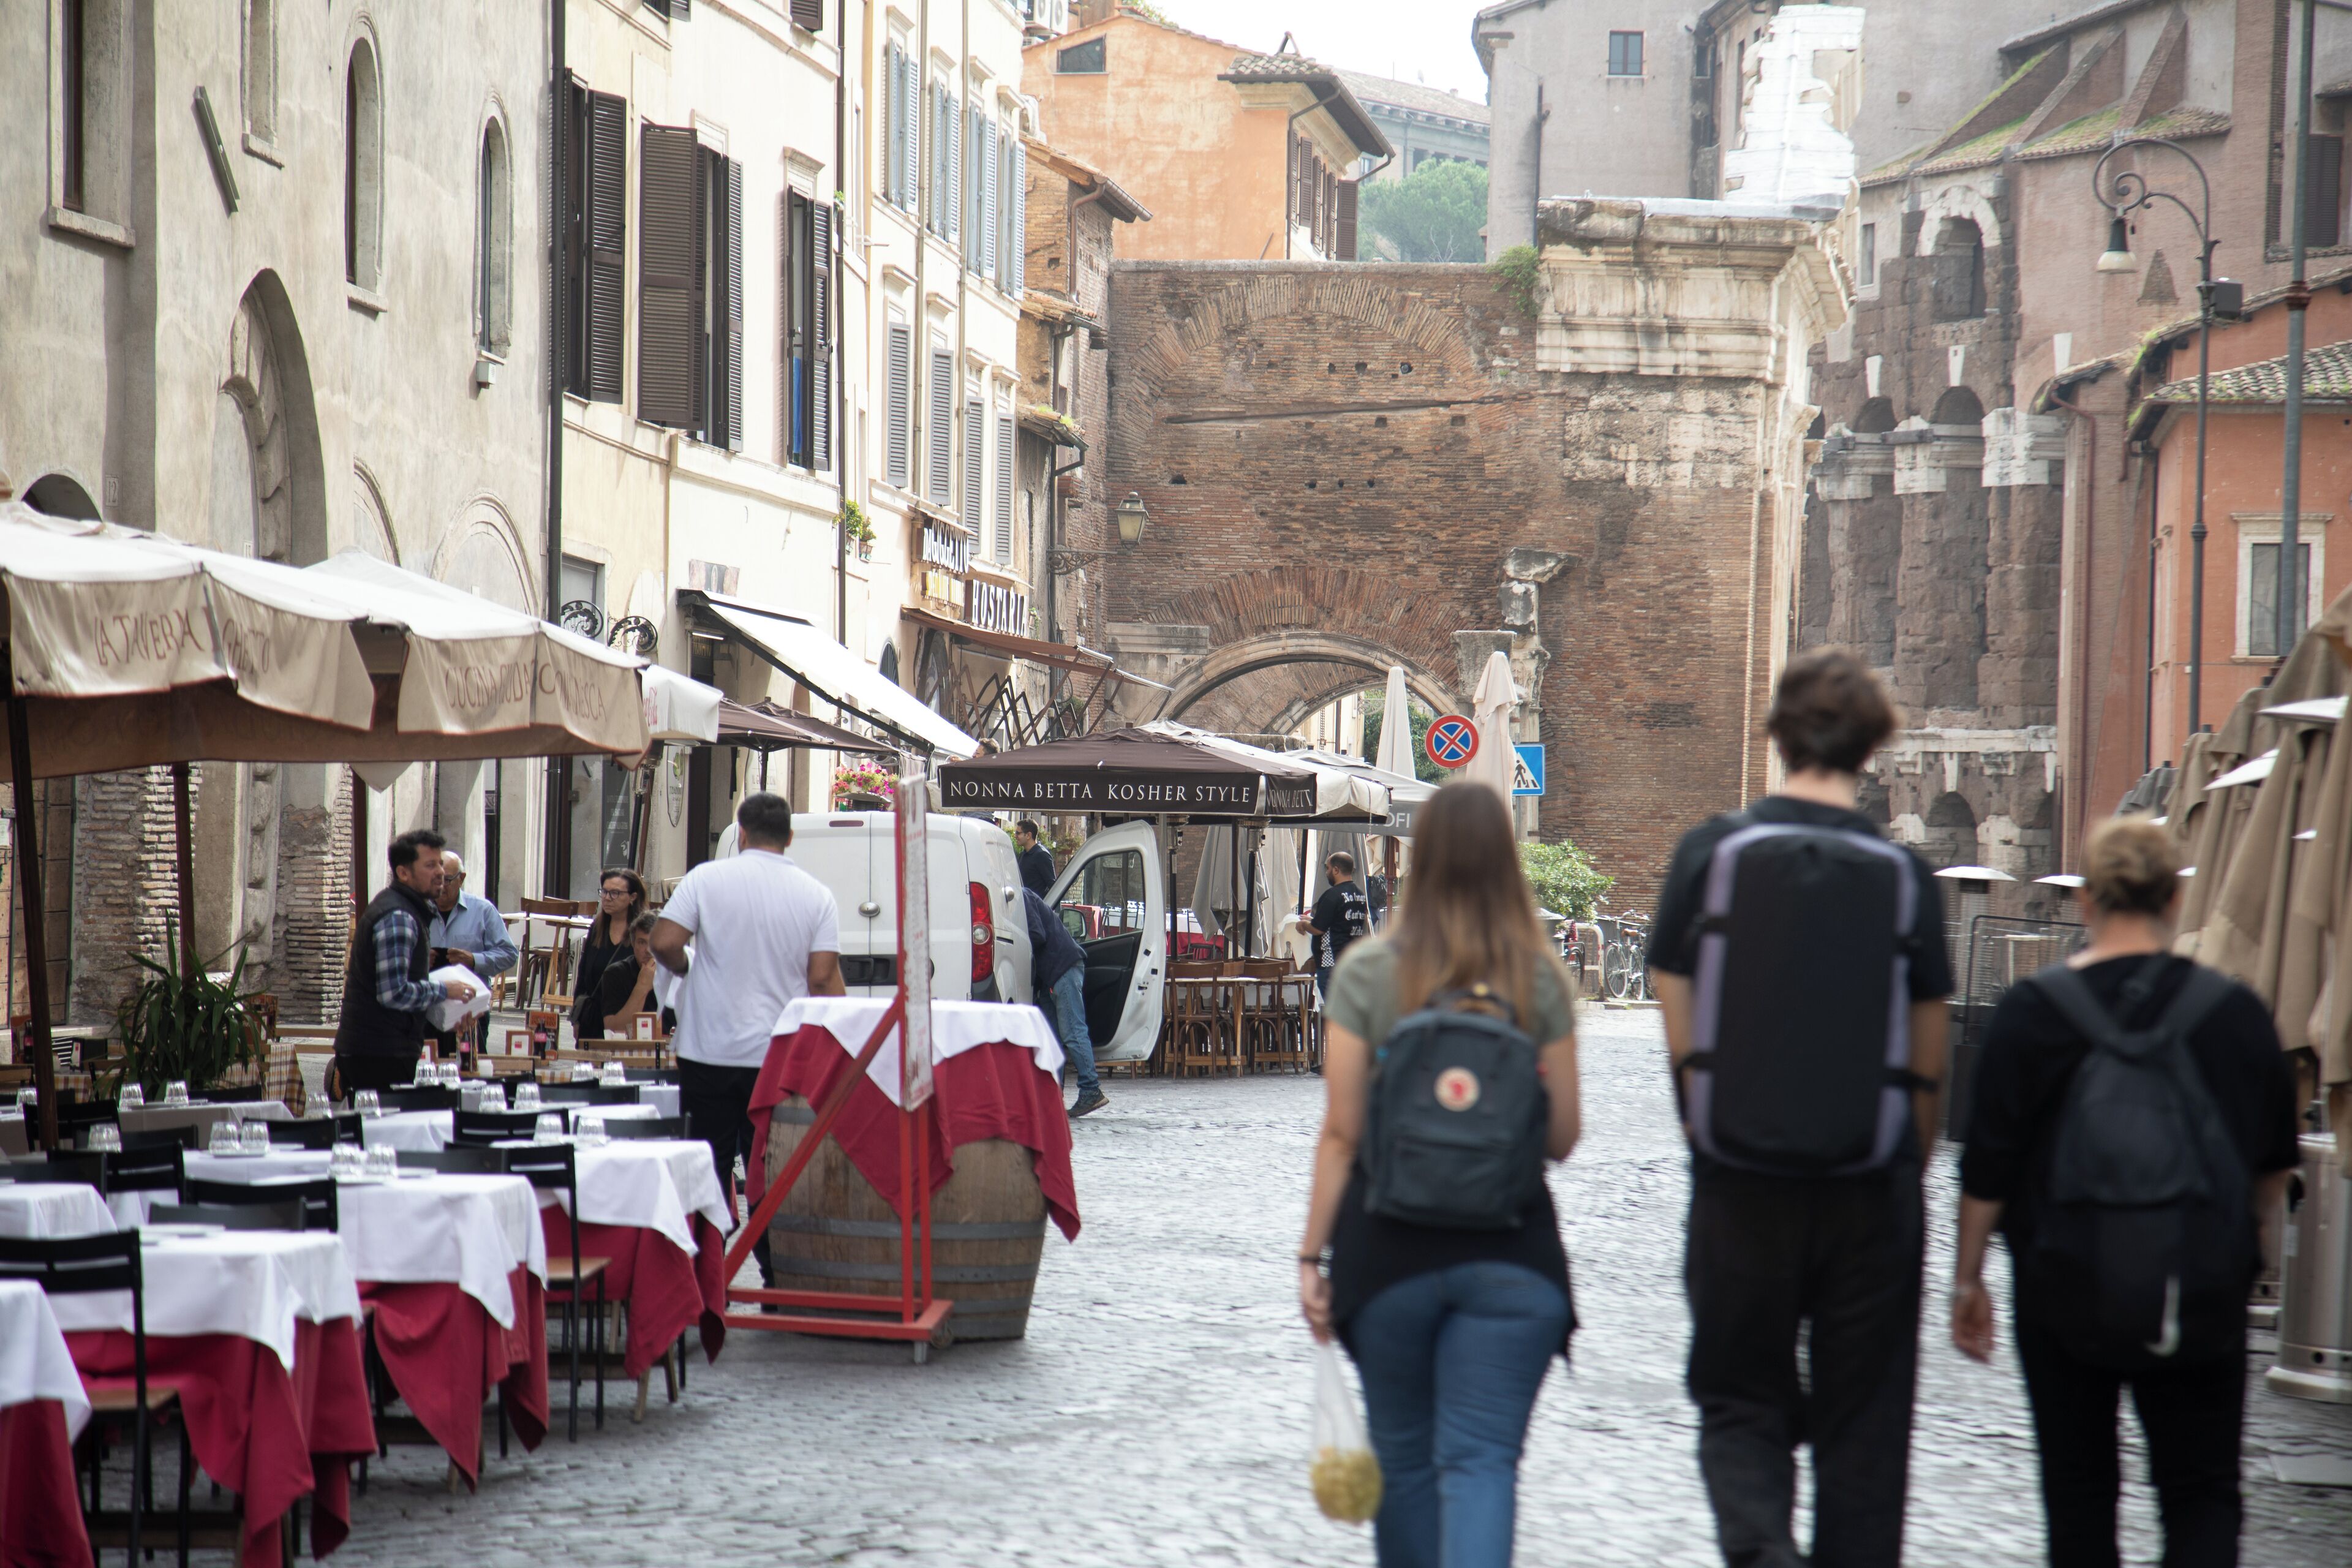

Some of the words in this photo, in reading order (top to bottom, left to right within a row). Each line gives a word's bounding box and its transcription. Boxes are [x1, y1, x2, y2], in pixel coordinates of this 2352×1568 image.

[971, 579, 1028, 637] HOSTARIA
[94, 615, 121, 666] LA
[950, 781, 1025, 797] NONNA
[1034, 782, 1093, 799] BETTA
[1107, 783, 1188, 801] KOSHER
[1195, 785, 1250, 803] STYLE
[1291, 788, 1313, 808] BETT
